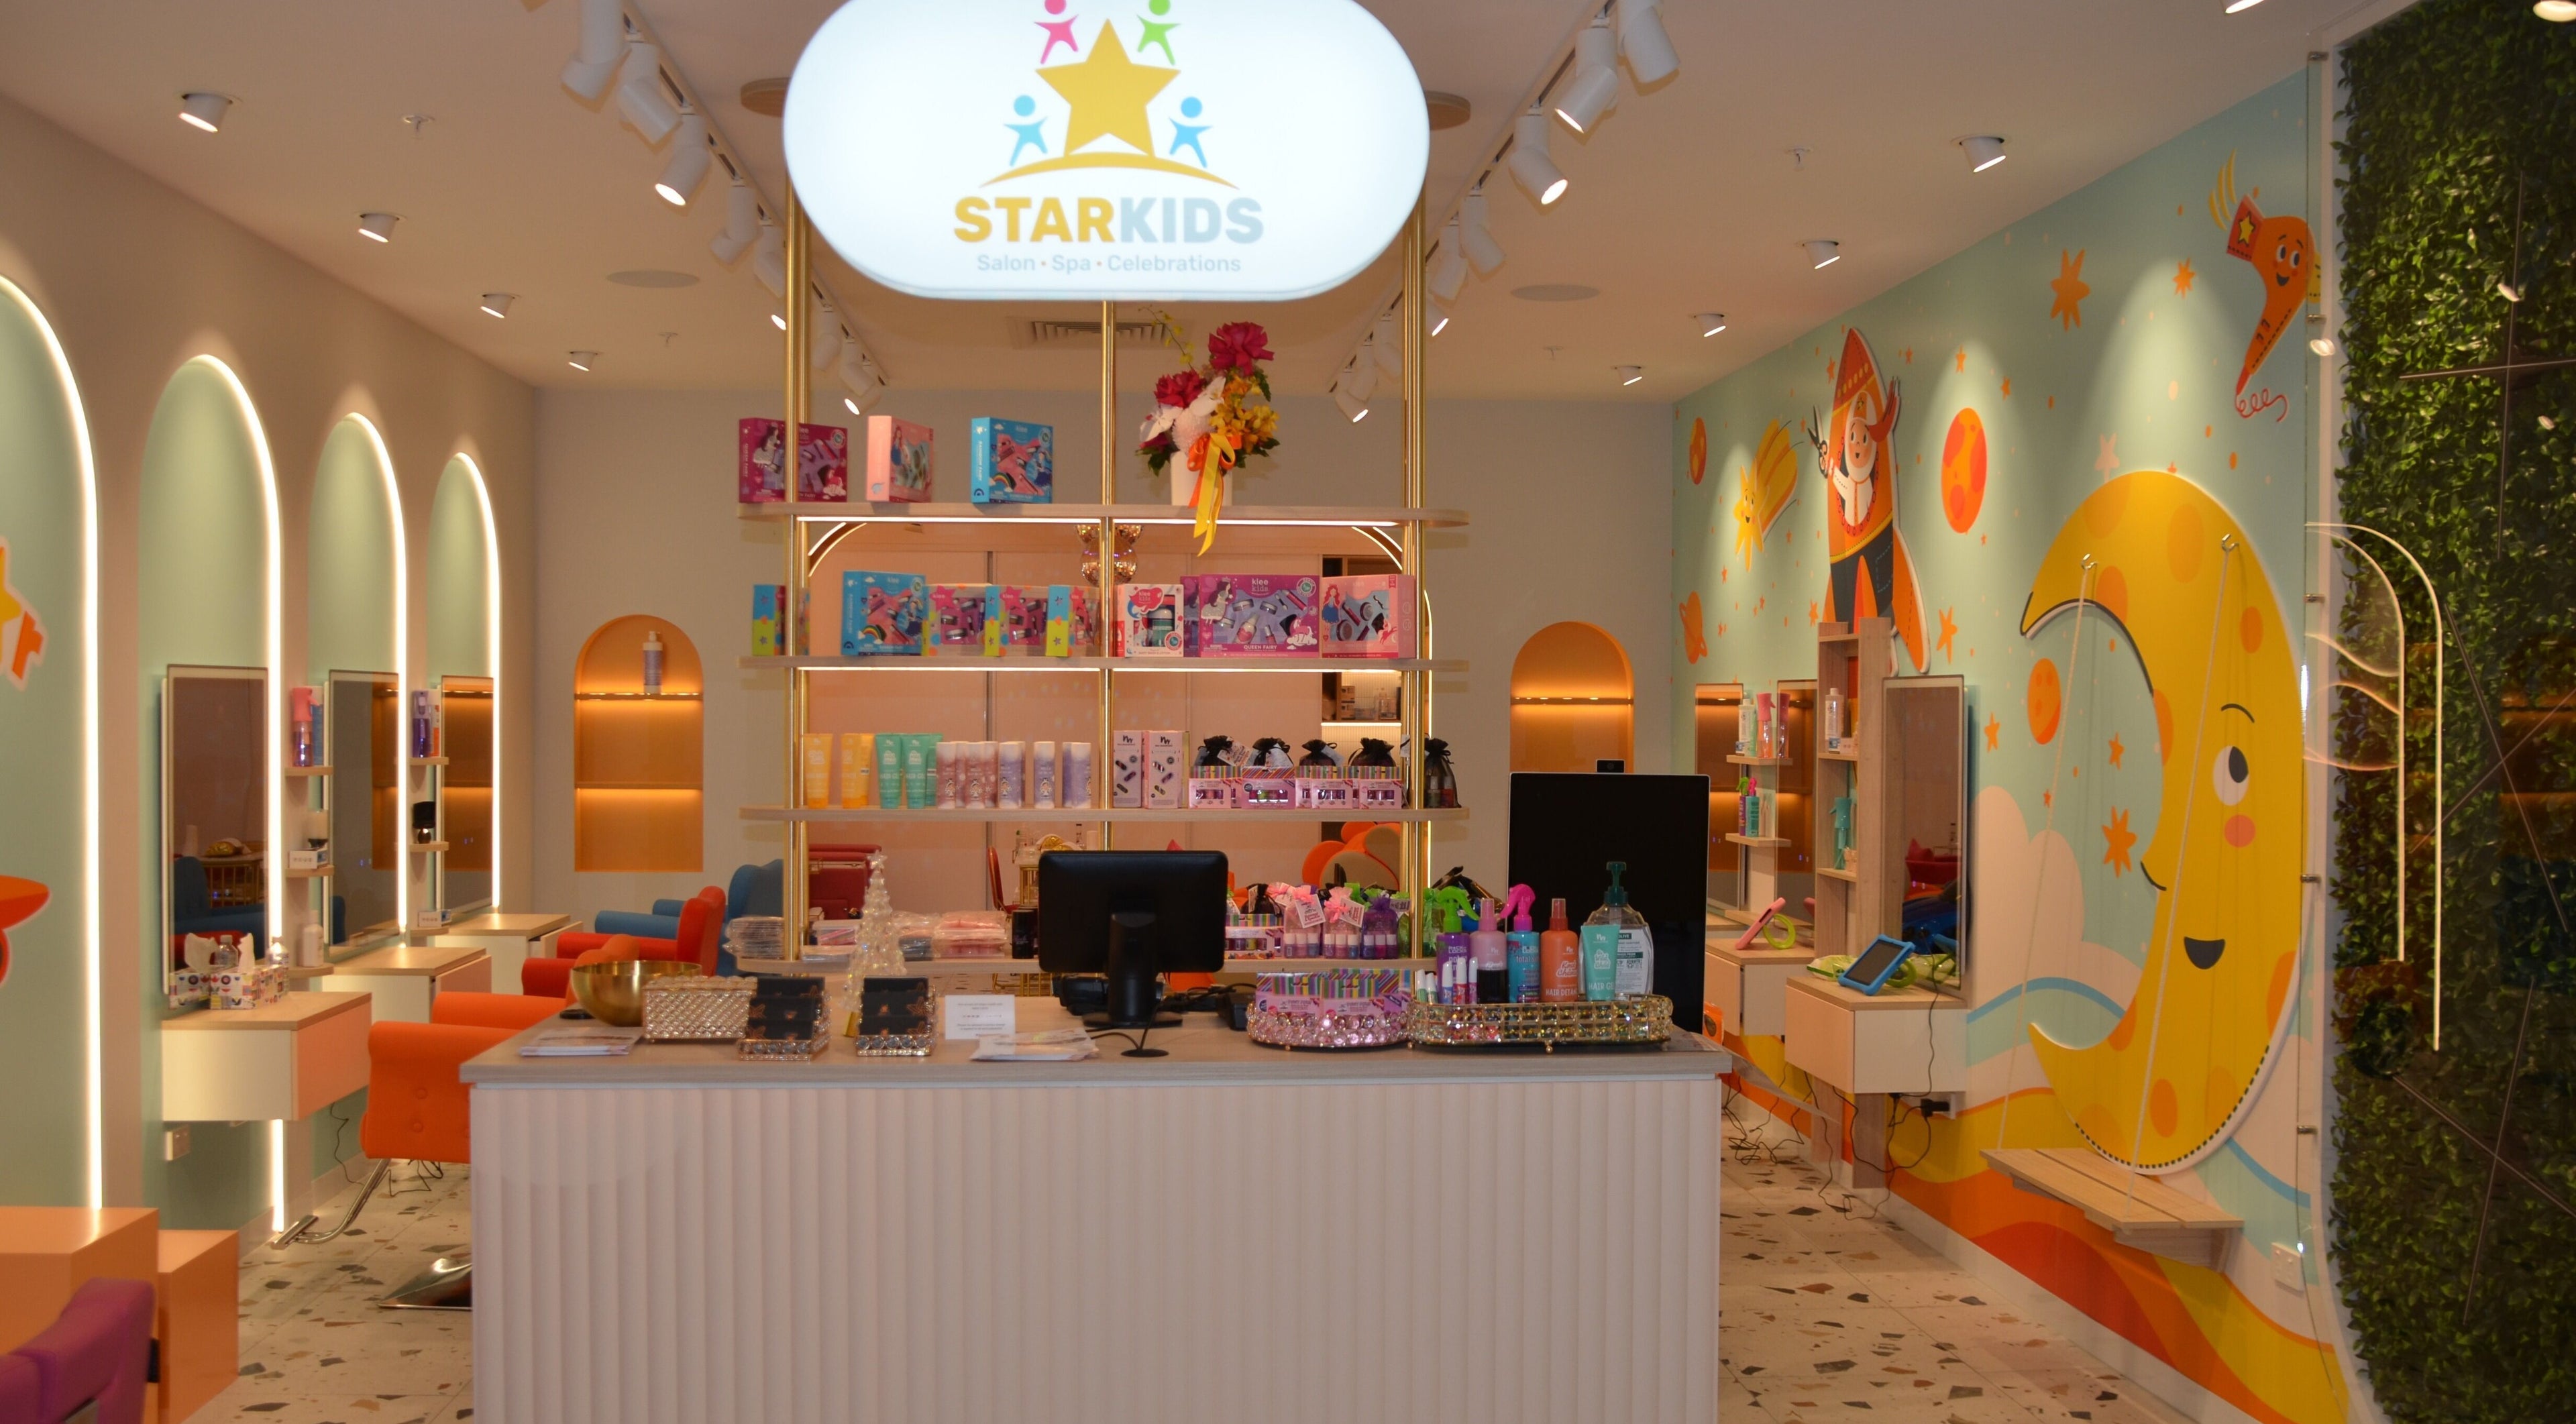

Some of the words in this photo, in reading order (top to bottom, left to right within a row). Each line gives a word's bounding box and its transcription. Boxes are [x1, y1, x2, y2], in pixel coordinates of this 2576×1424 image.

[954, 196, 1264, 243] STARKIDS
[977, 254, 1035, 271] Salon
[1052, 254, 1091, 275] Spa
[1107, 254, 1242, 272] Celebrations
[1546, 988, 1560, 996] HAIR
[1589, 982, 1604, 991] HAIR
